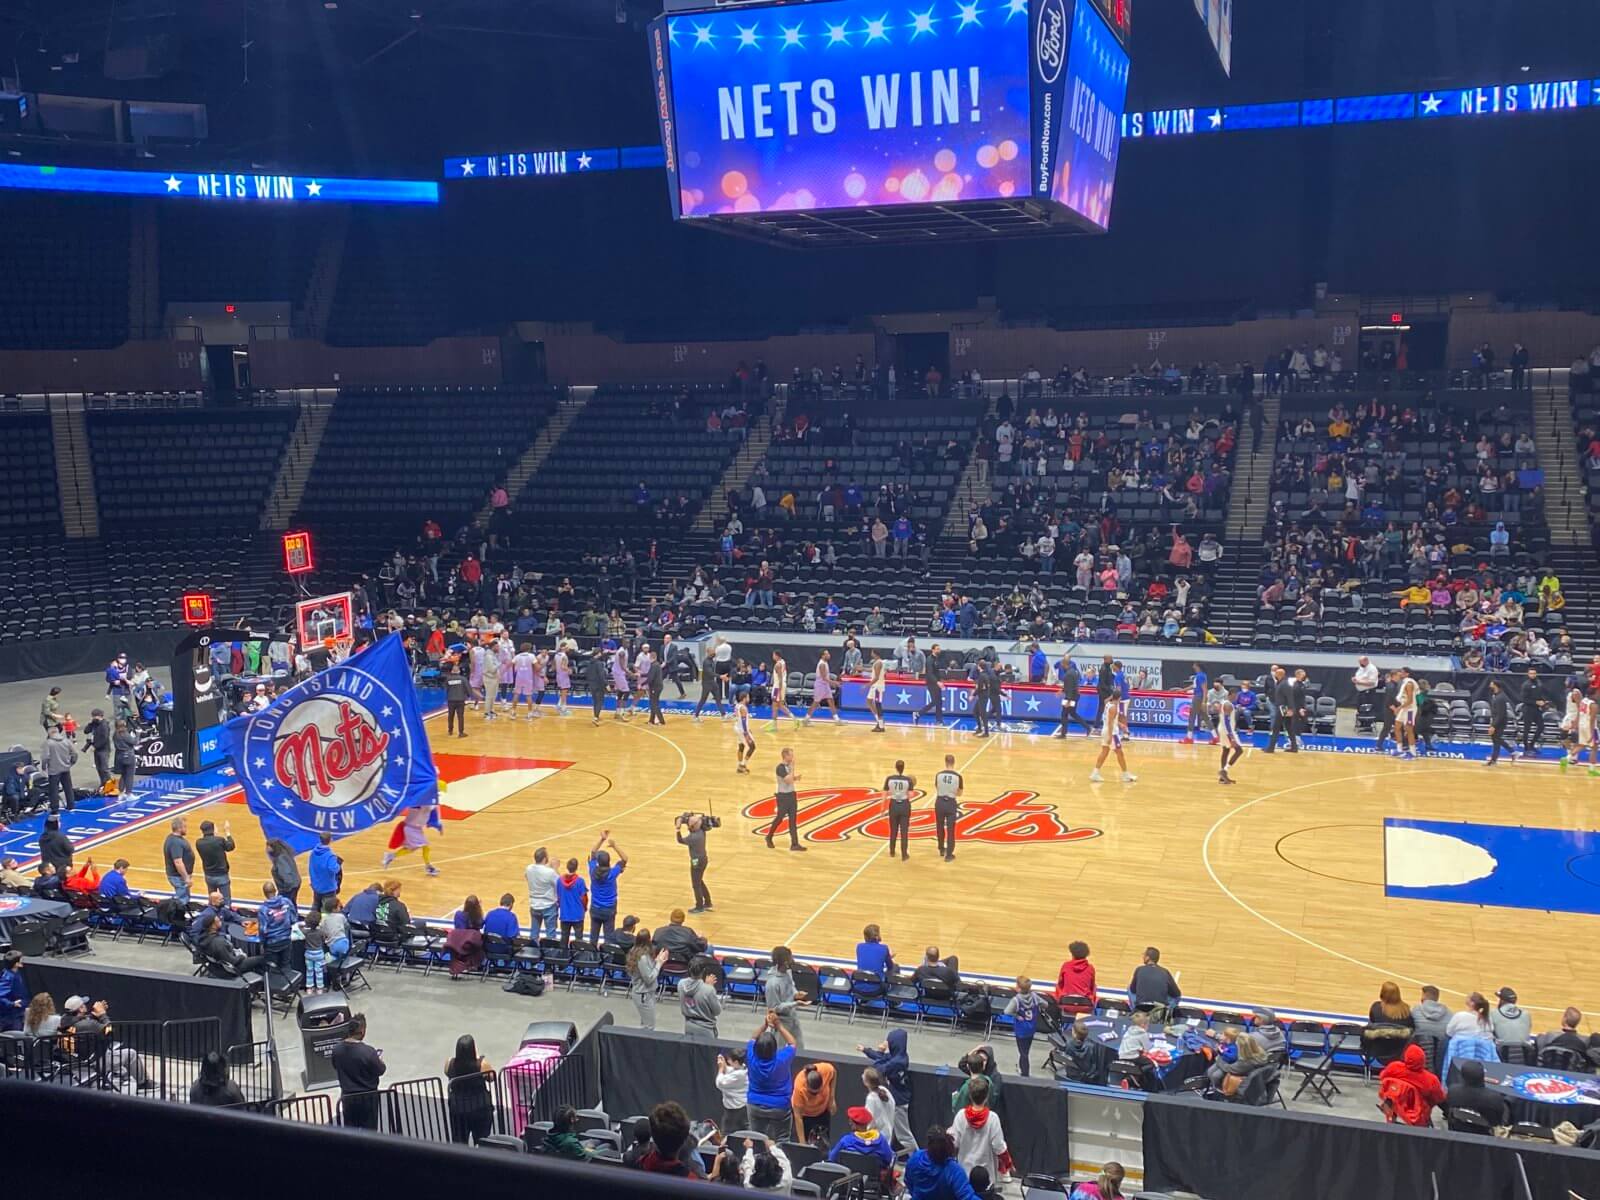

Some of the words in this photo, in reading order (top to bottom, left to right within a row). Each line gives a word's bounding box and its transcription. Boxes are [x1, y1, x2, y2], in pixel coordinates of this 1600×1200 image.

[1040, 8, 1061, 67] Ford
[718, 78, 836, 141] NETS
[861, 66, 981, 130] WIN!
[1529, 80, 1578, 110] WIN
[1069, 75, 1096, 145] NETS
[1094, 99, 1117, 162] WIN!
[1152, 108, 1194, 135] WIN
[1039, 93, 1052, 192] BuyFordNow.com
[533, 151, 567, 174] WIN
[254, 175, 294, 199] WIN
[300, 671, 373, 700] ISLAND
[926, 687, 968, 712] NTS
[1130, 711, 1148, 721] 113
[1134, 698, 1166, 709] 0:00.0
[1152, 713, 1171, 723] 109
[202, 740, 217, 752] HS
[274, 701, 390, 801] Nets
[134, 752, 184, 769] PALDING
[893, 781, 904, 791] 70
[96, 788, 211, 824] ISLAND
[314, 809, 356, 829] NEW
[363, 782, 401, 820] YORK
[742, 787, 1104, 845] Nets
